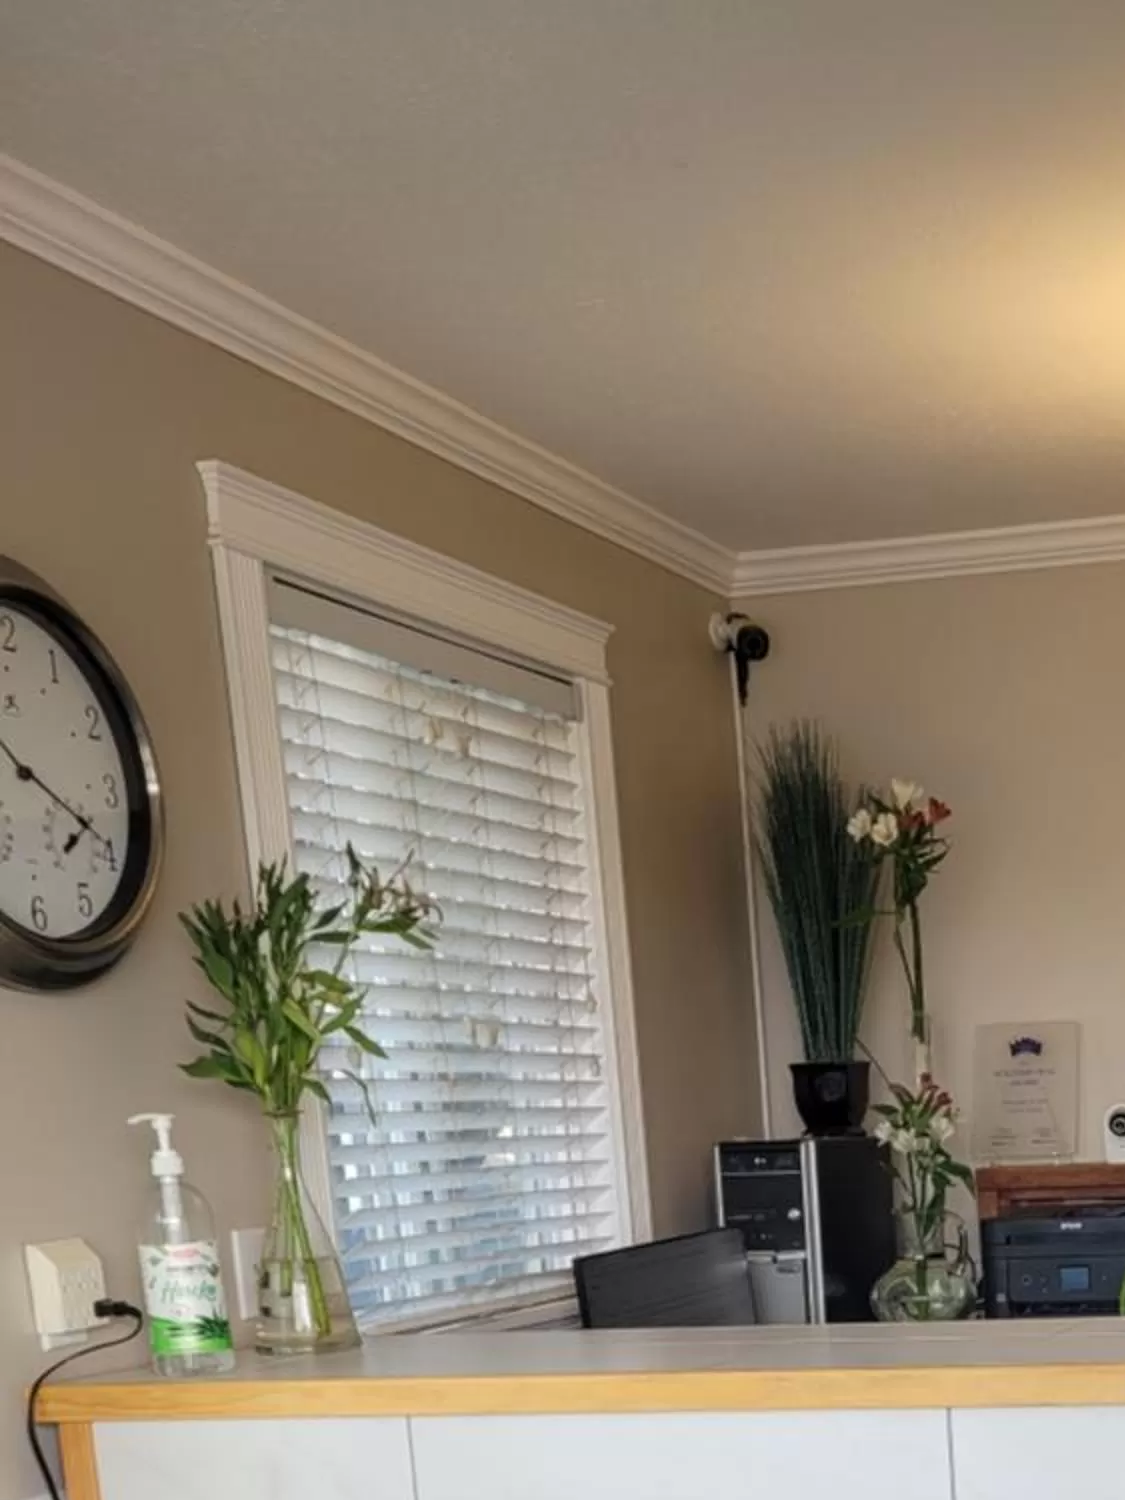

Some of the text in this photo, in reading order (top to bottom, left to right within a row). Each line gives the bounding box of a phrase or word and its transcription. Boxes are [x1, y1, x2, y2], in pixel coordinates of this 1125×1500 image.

[49, 648, 59, 684] 1
[85, 704, 102, 742] 2
[102, 773, 119, 810] 3
[103, 837, 119, 873] 4
[30, 895, 49, 932] 6
[76, 881, 93, 918] 5
